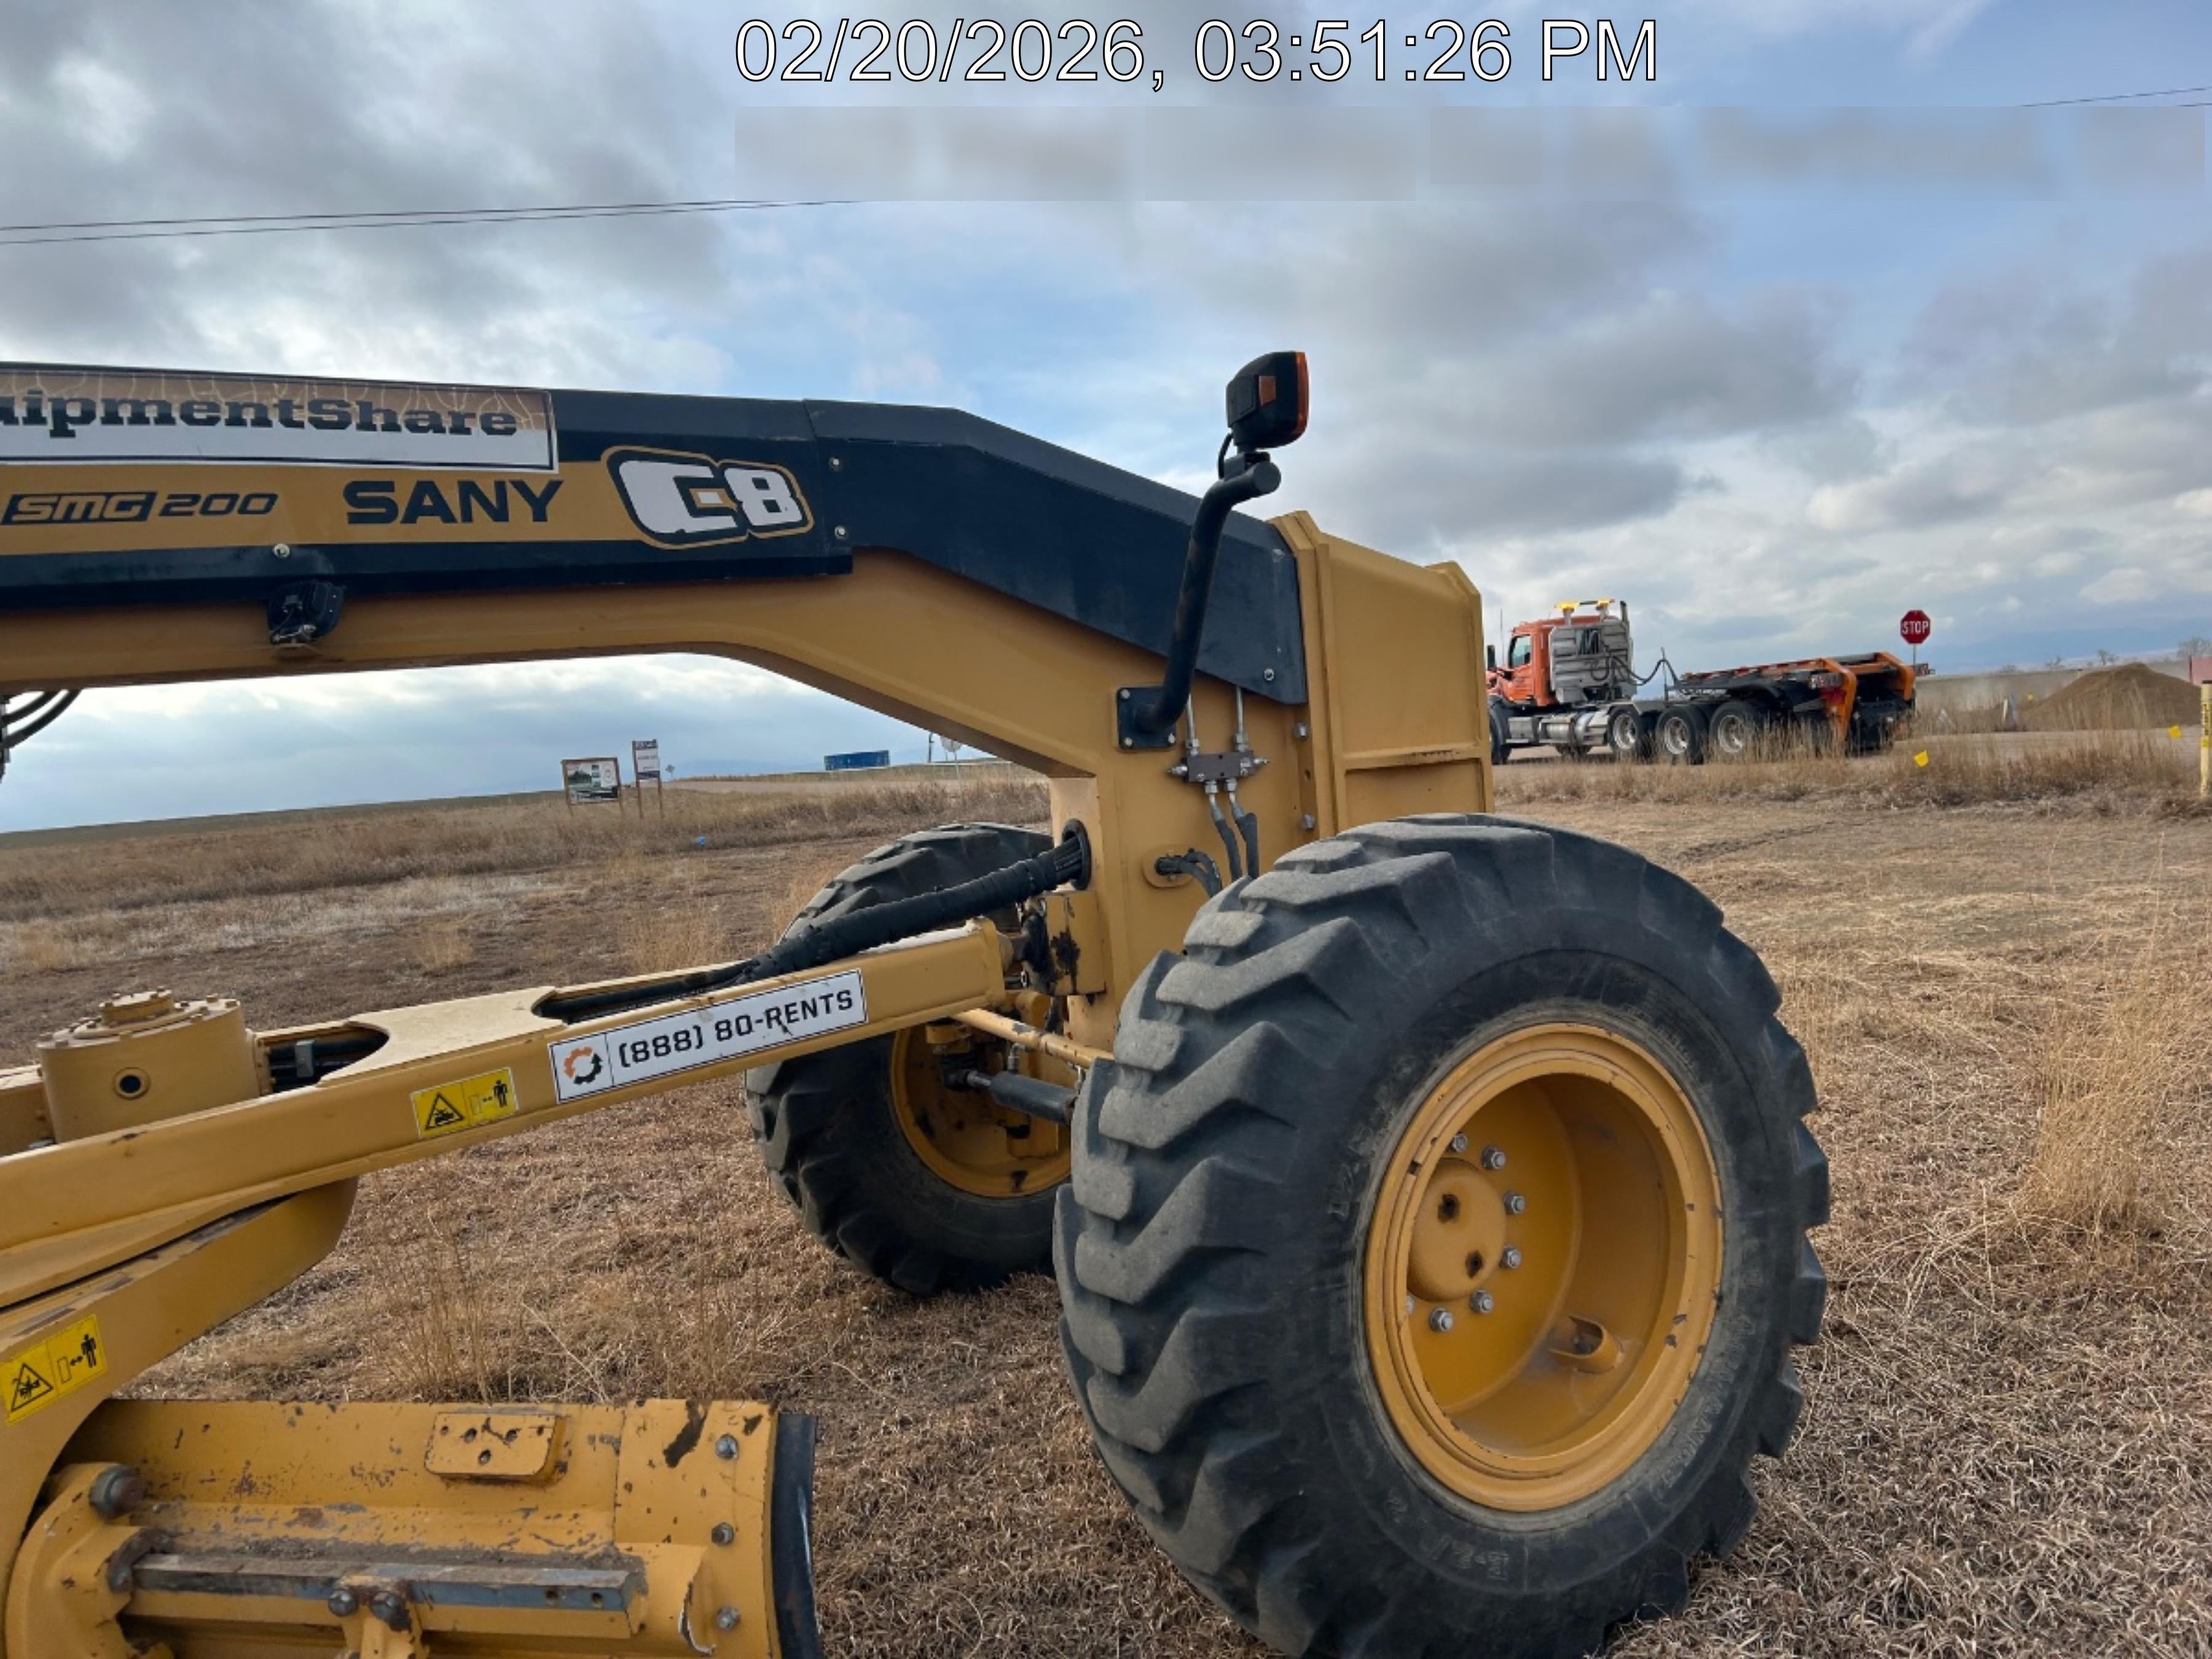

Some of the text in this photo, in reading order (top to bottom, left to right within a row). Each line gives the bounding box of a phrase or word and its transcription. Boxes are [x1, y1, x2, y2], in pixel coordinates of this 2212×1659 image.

[11, 493, 278, 522] SMG 200
[343, 480, 564, 524] SANY
[1902, 621, 1929, 635] STOP
[619, 989, 853, 1067] (888) 80-RENTS
